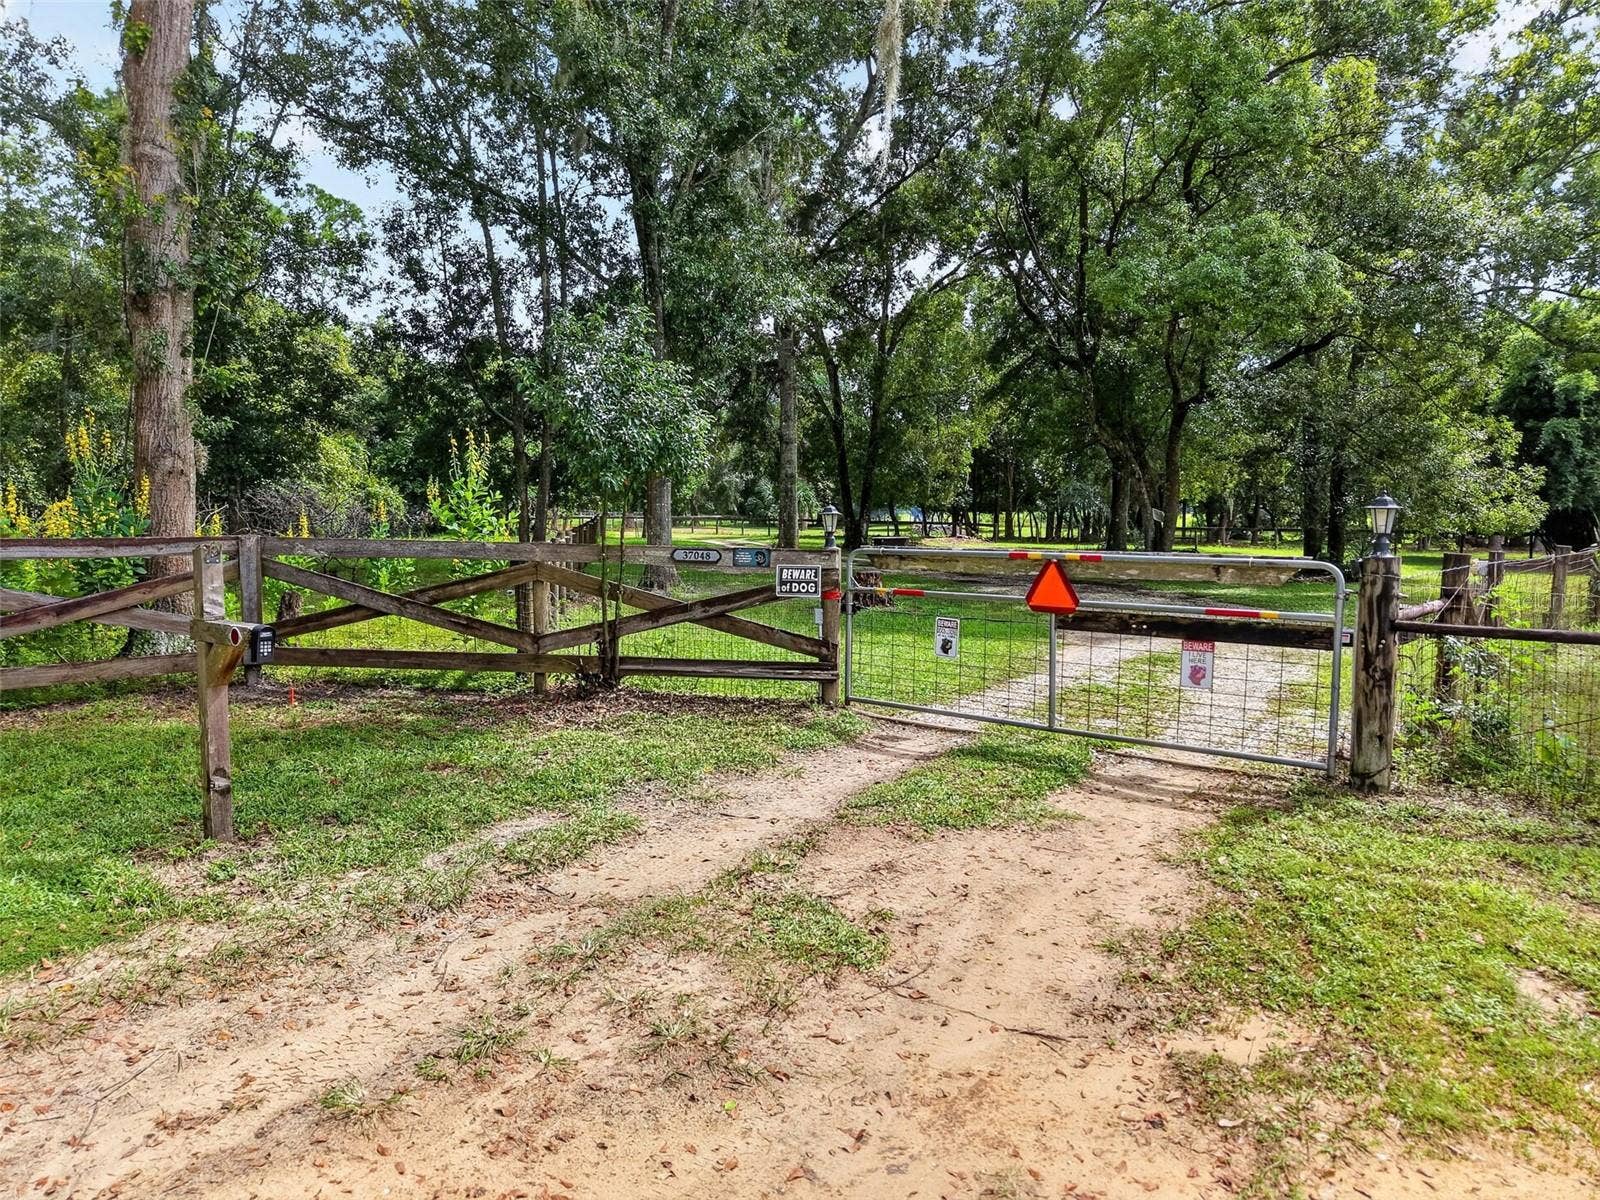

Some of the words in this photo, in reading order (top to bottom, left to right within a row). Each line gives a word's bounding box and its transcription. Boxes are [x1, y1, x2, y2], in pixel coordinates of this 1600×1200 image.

[683, 551, 711, 560] 37048
[782, 568, 818, 580] BEWARE
[781, 583, 790, 592] of
[792, 583, 816, 593] DOG
[1184, 642, 1213, 651] BEWARE
